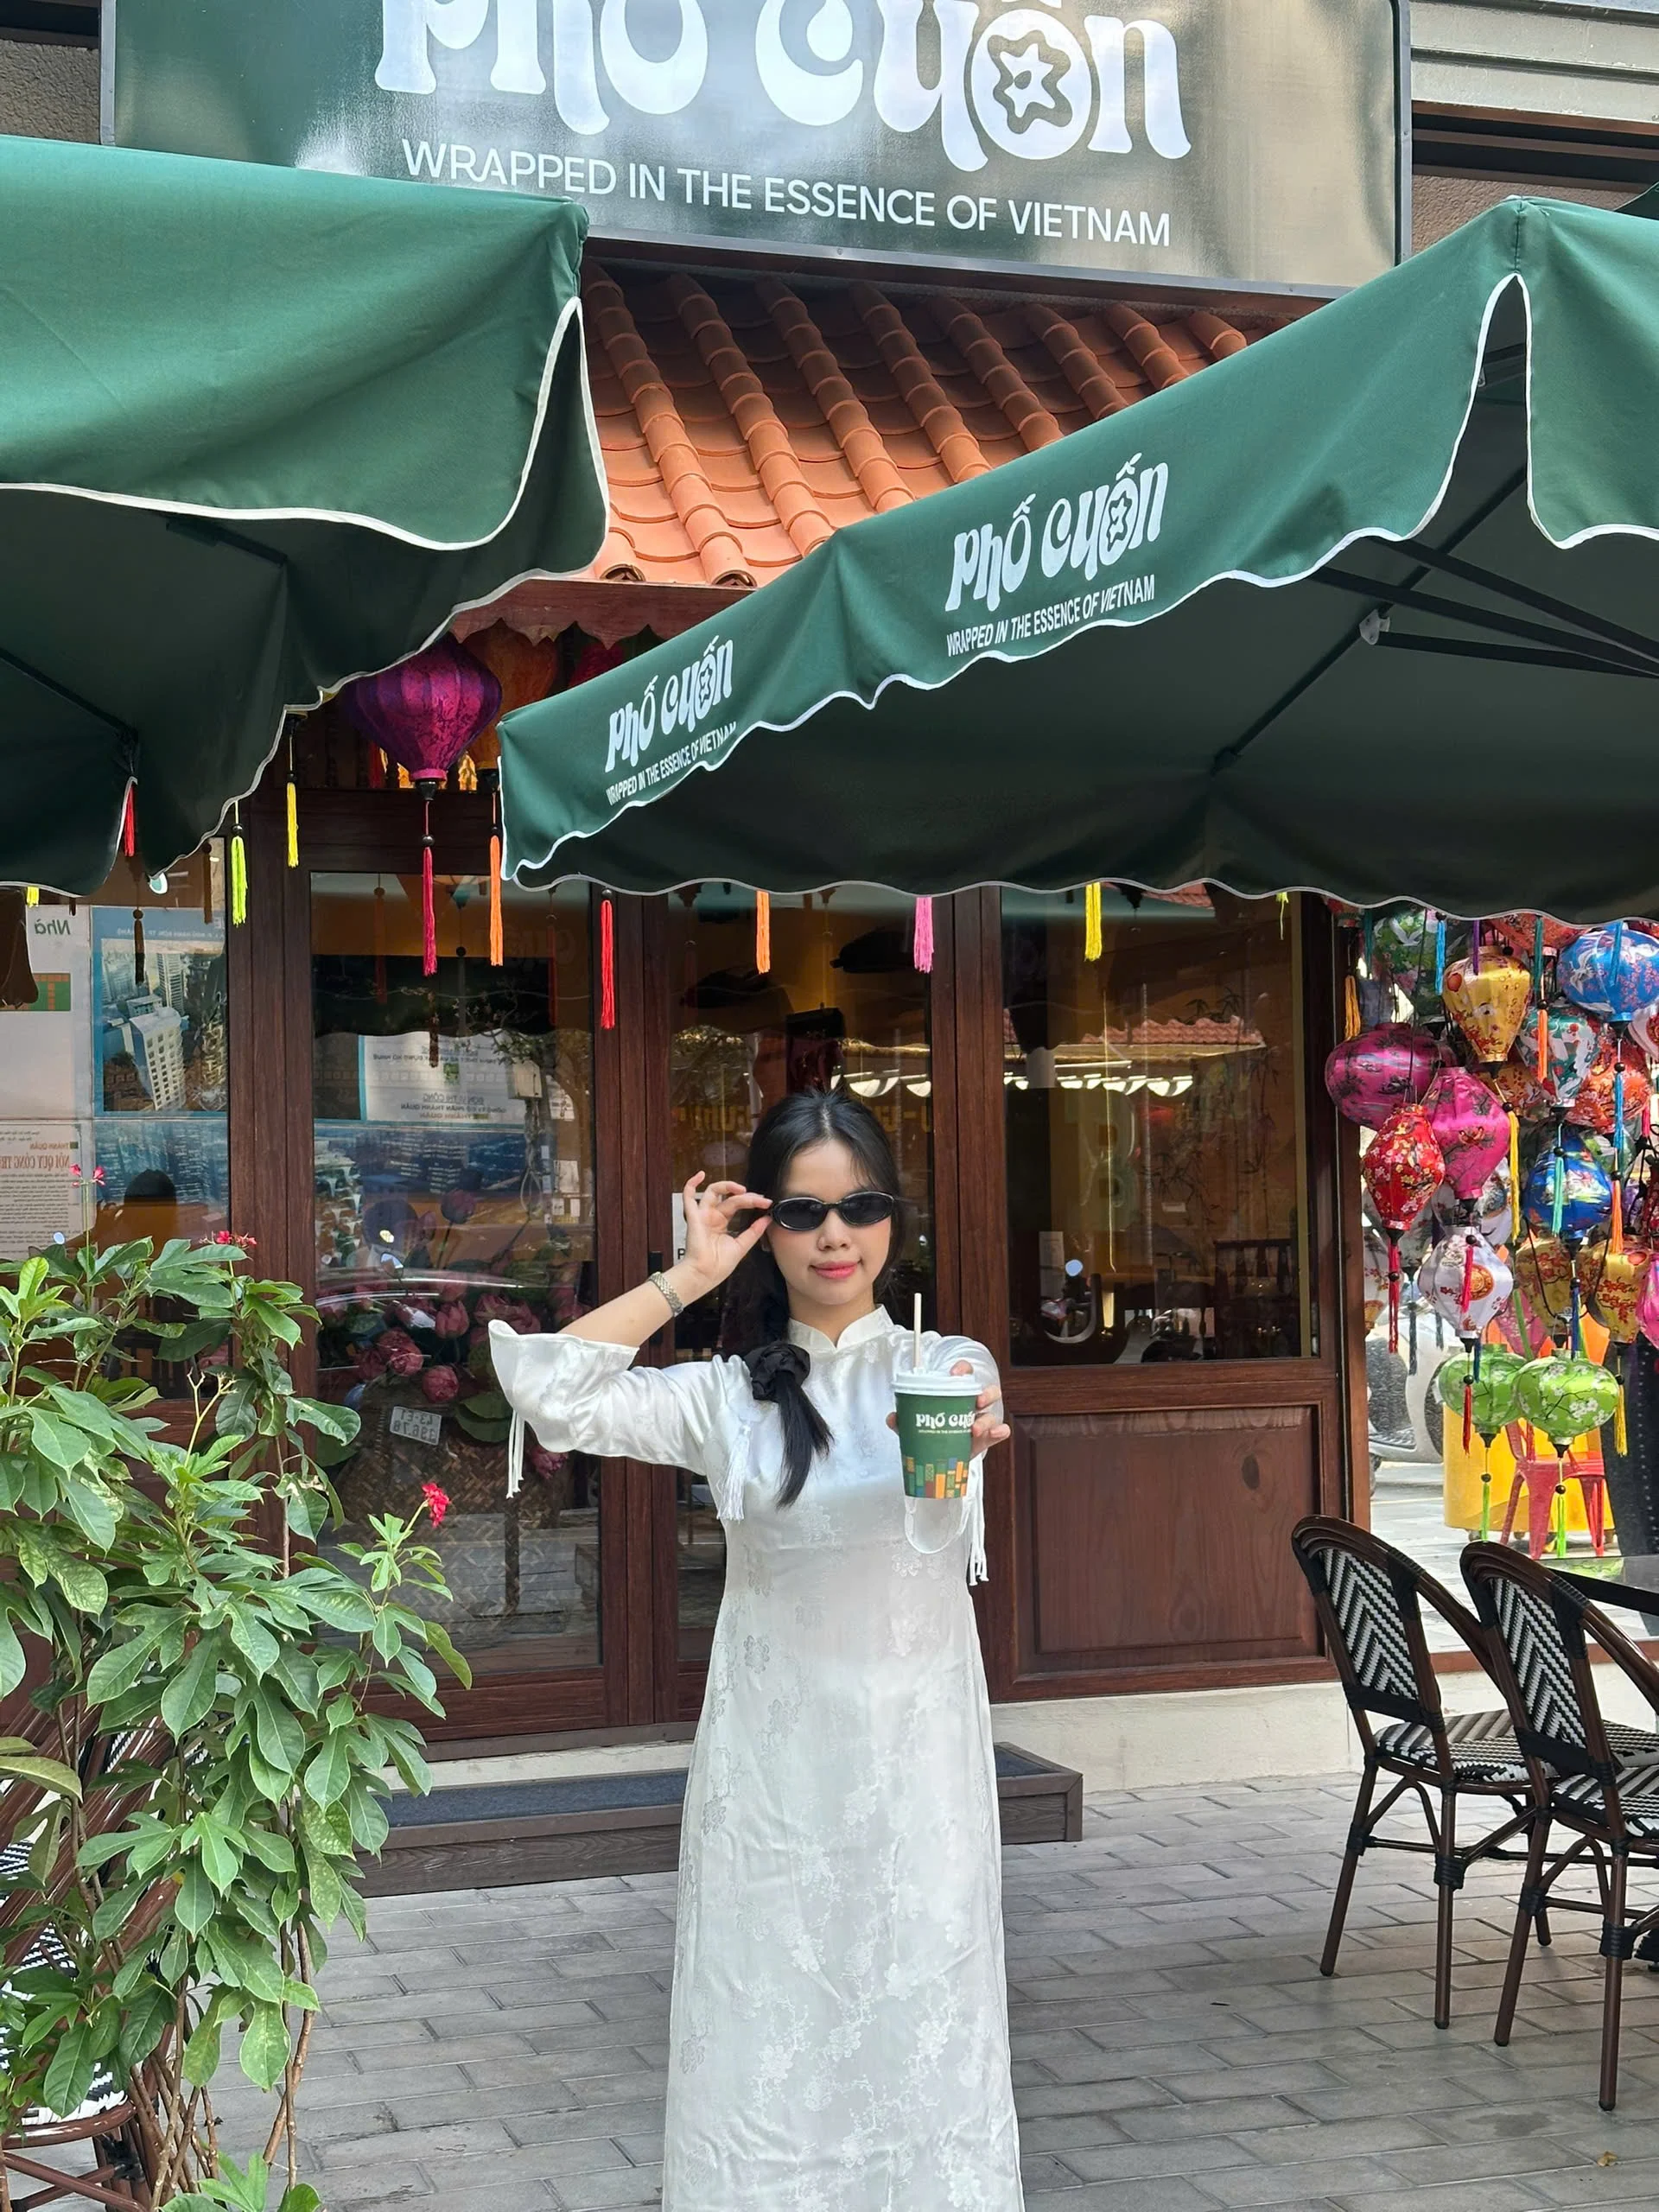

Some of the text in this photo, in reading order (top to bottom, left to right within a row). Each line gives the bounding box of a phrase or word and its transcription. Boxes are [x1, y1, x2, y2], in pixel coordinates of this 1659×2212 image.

[402, 138, 1171, 247] WRAPPED IN THE ESSENCE OF VIETNAM
[946, 574, 1155, 657] WRAPPED IN THE ESSENCE OF VIETNAM
[606, 782, 638, 806] WRAPPED
[637, 770, 646, 791] IN
[646, 763, 661, 785] THE
[659, 745, 692, 779] ESSENCE
[690, 739, 700, 761] OF
